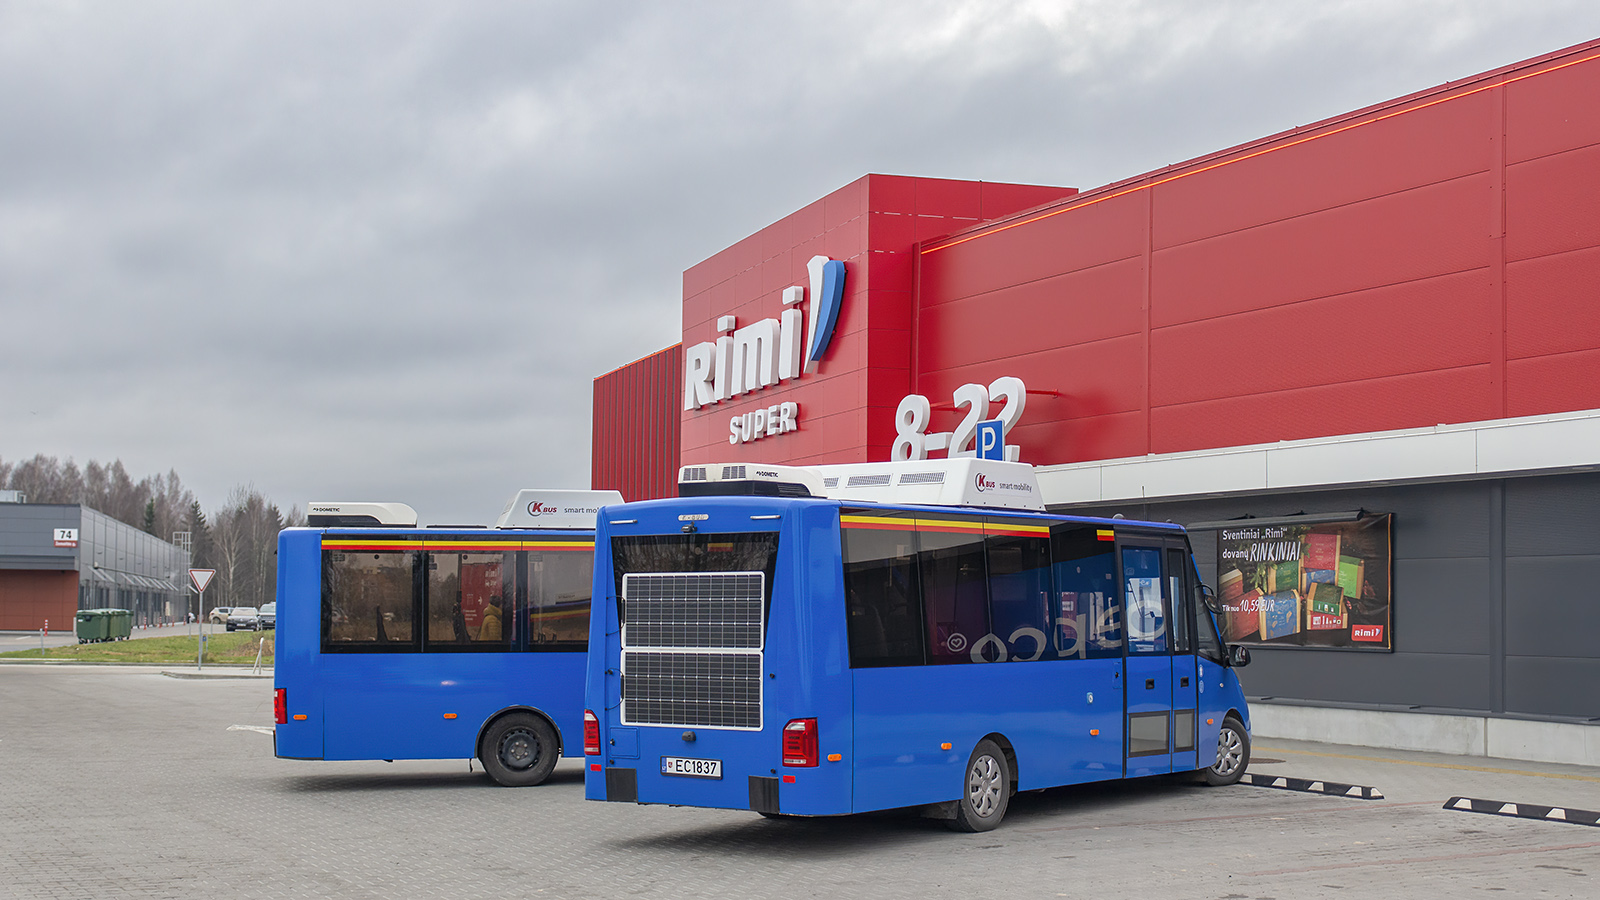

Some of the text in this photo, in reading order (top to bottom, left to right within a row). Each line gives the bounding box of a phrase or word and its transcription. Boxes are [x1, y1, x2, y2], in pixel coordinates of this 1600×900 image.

[684, 286, 804, 411] Rimi
[729, 401, 798, 445] SUPER
[999, 482, 1013, 490] smart
[1013, 482, 1032, 493] mobility
[60, 530, 72, 539] 74
[1249, 541, 1301, 562] RINKINIAI
[1222, 604, 1231, 612] Tik
[1239, 599, 1259, 614] 10,59
[1259, 600, 1275, 612] EUR
[1354, 629, 1375, 637] Rimi
[676, 759, 717, 775] EC1837
